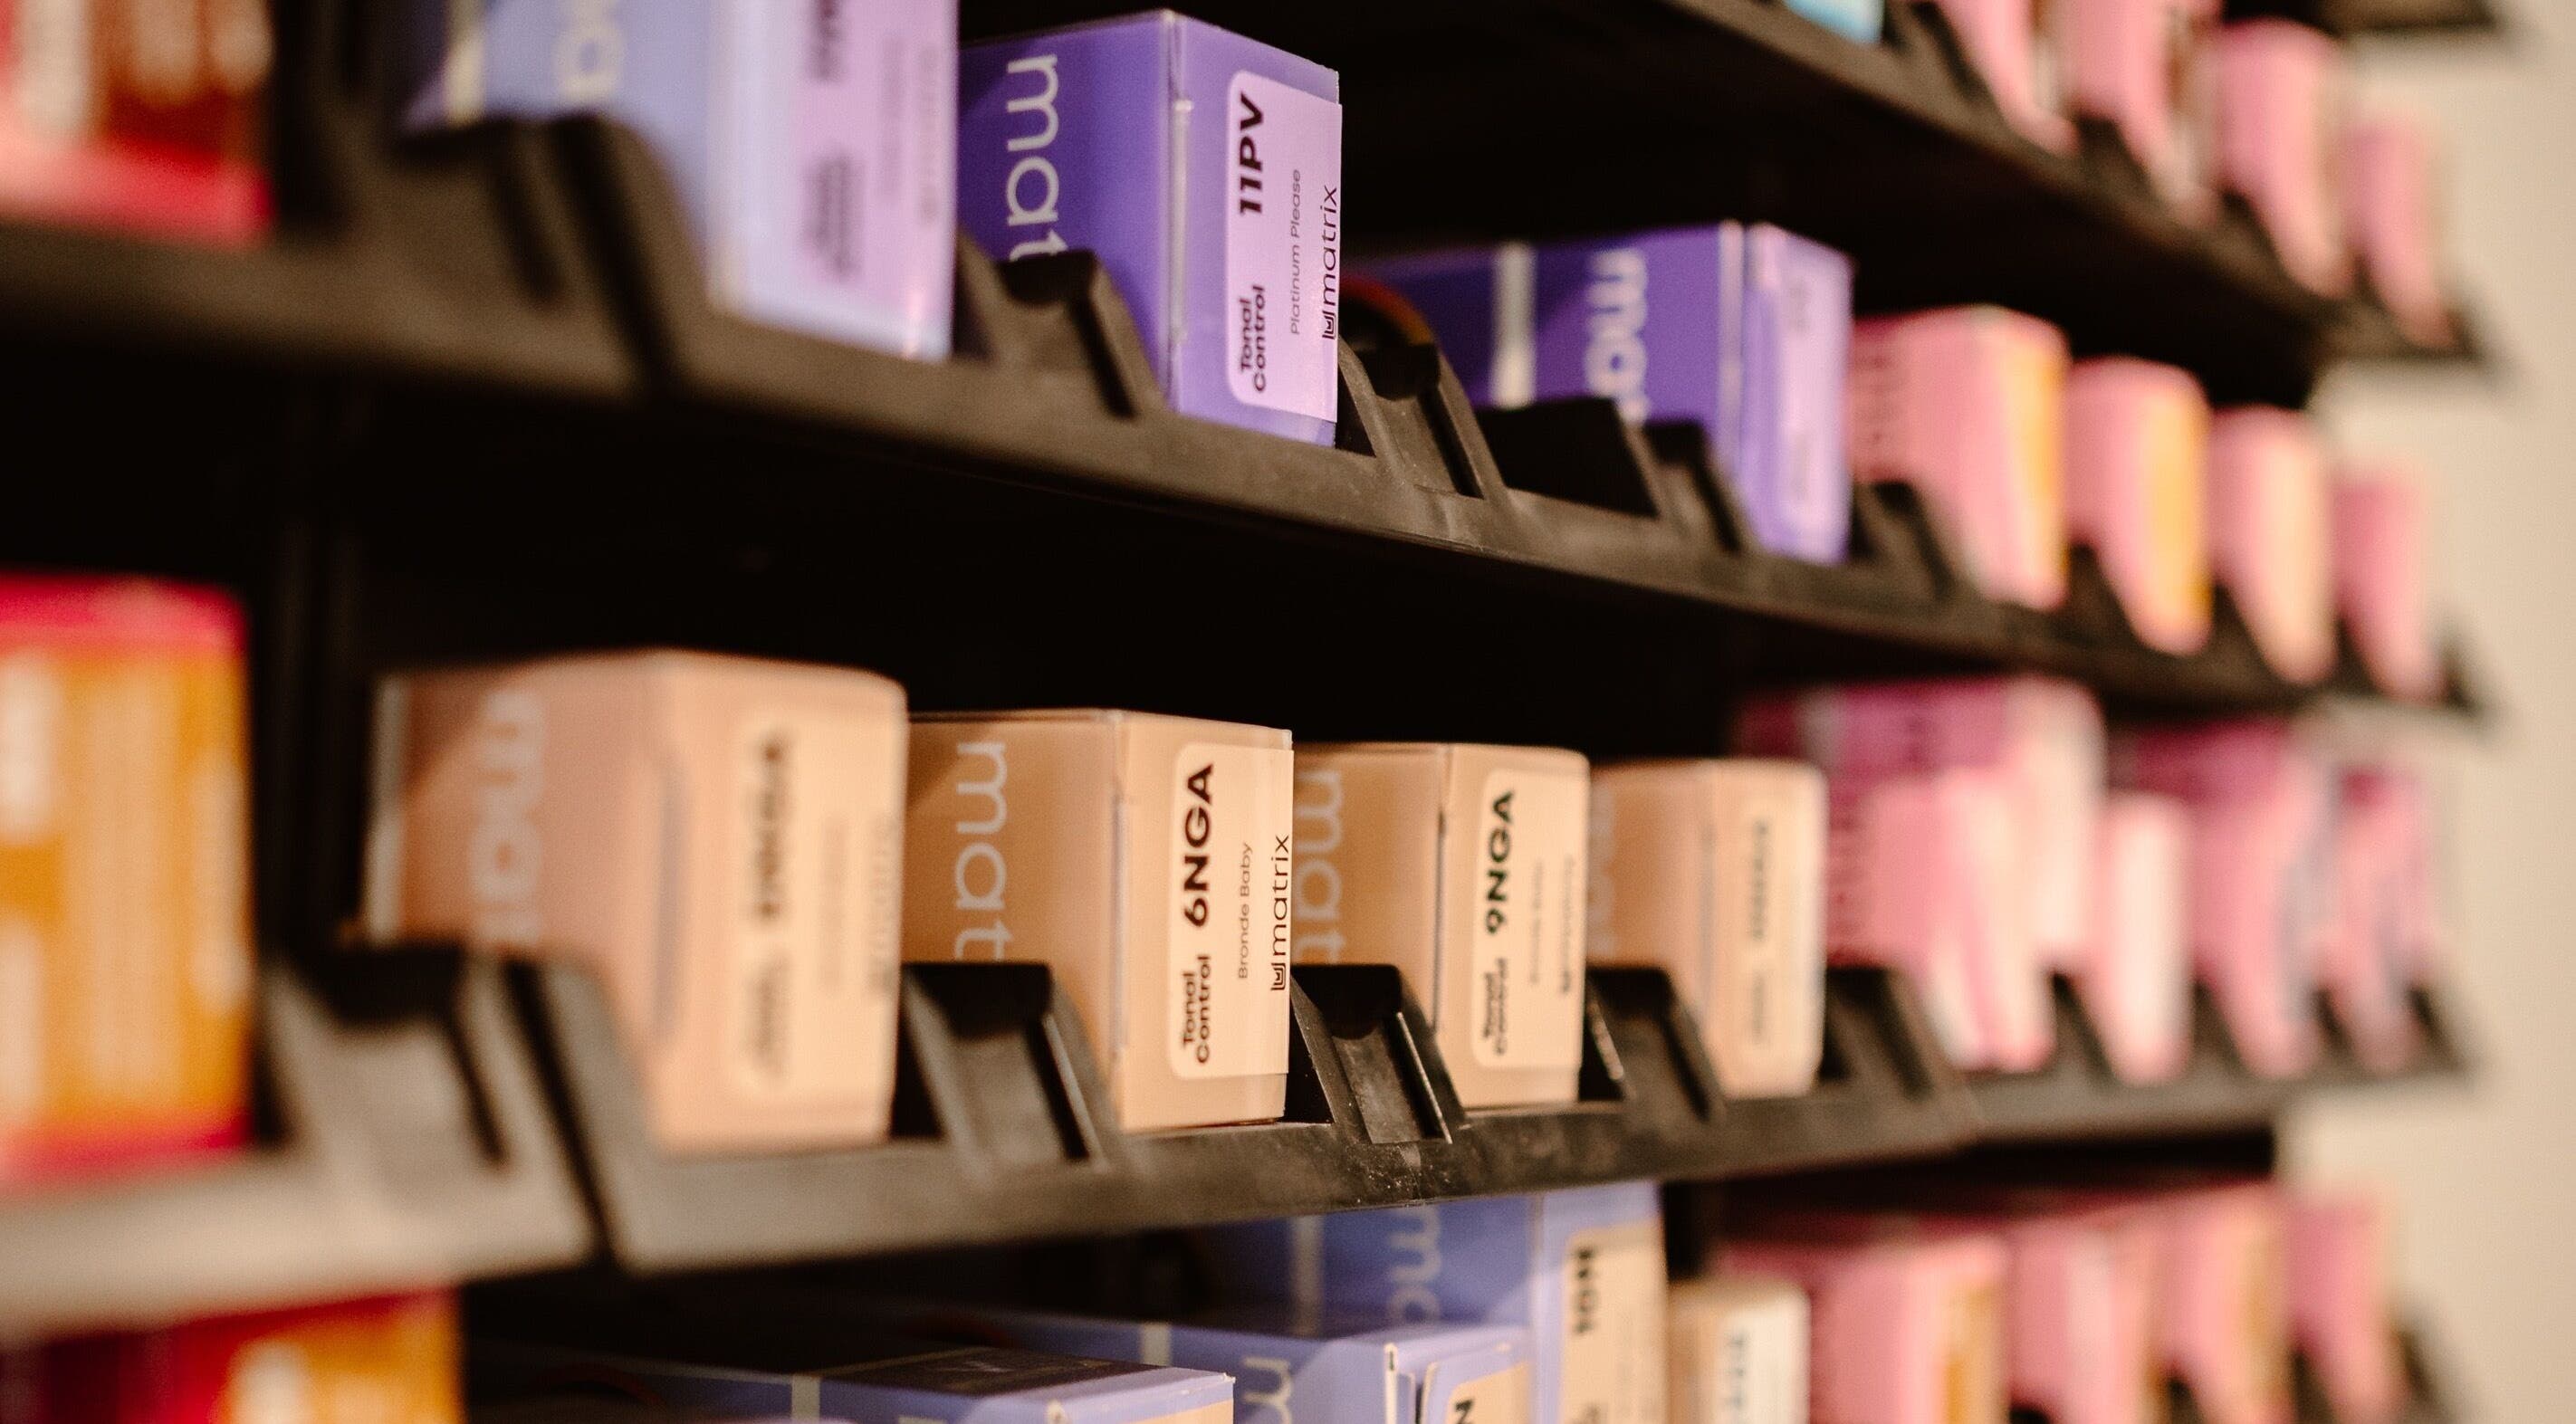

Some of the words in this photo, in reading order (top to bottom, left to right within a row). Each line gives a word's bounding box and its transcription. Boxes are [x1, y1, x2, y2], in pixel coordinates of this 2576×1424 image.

[1238, 91, 1264, 215] 11PV
[1290, 168, 1301, 239] Please
[1290, 244, 1300, 336] Platinum
[1319, 184, 1338, 307] matrix
[1239, 297, 1253, 373] Tonal
[1253, 284, 1266, 393] Control
[1183, 763, 1214, 928] 6NGA
[1240, 842, 1253, 897] Baby
[1270, 834, 1289, 957] matrix
[1484, 789, 1514, 934] 9NGA
[1238, 903, 1250, 980] Bronde
[1182, 970, 1196, 1049] Tonal
[1196, 954, 1211, 1064] Control
